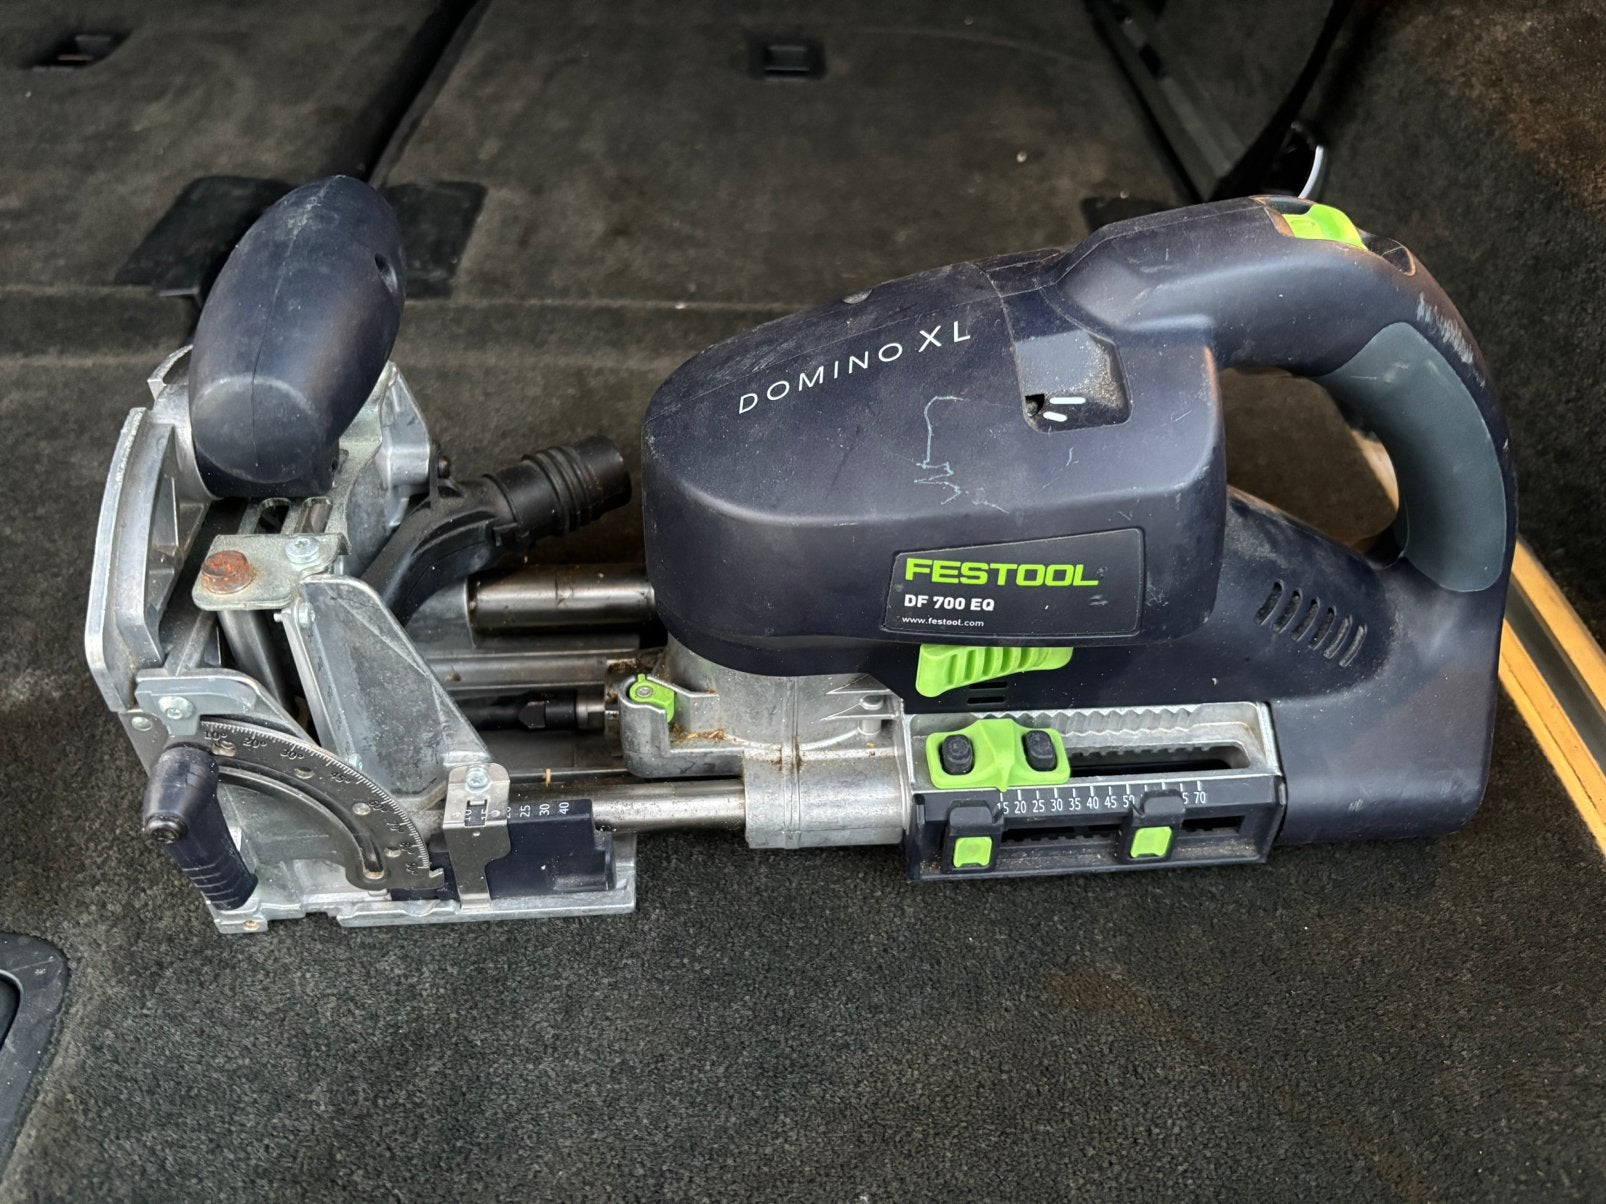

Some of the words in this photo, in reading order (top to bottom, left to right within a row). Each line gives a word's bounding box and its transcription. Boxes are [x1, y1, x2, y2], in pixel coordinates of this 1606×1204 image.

[739, 342, 903, 415] DOMINO
[918, 320, 971, 353] XL
[904, 557, 1099, 587] FESTOOL
[904, 594, 928, 608] DF
[933, 596, 966, 611] 700
[970, 598, 995, 612] EQ
[902, 615, 985, 628] www.festool.com
[520, 804, 531, 818] 25
[539, 803, 551, 816] 30
[559, 801, 570, 815] 40
[1014, 800, 1027, 814] 20
[1032, 799, 1045, 813] 25
[1050, 798, 1063, 812] 30
[1068, 797, 1081, 811] 35
[1086, 796, 1099, 810] 40
[1104, 795, 1117, 809] 45
[1194, 791, 1206, 804] 70
